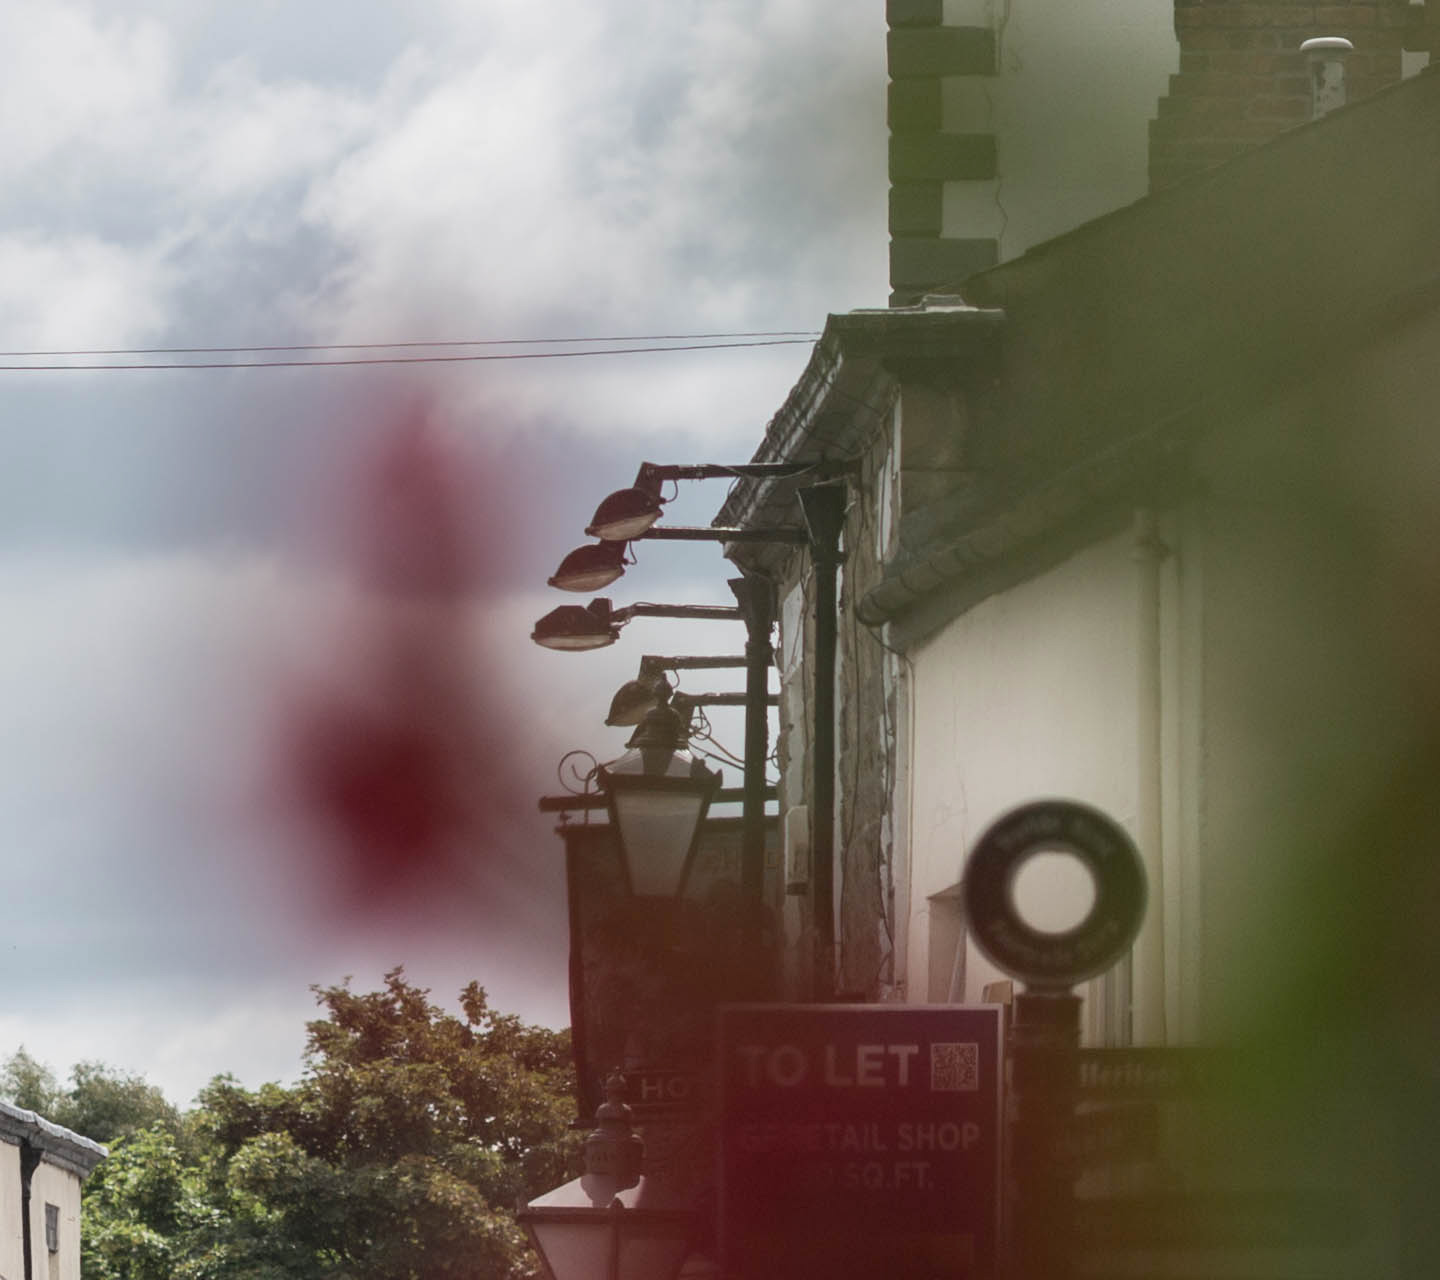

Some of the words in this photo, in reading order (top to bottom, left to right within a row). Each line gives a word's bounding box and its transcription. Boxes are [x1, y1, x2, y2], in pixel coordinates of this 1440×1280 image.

[735, 1043, 809, 1088] TO
[824, 1044, 920, 1087] LET
[897, 1122, 981, 1152] SHOP
